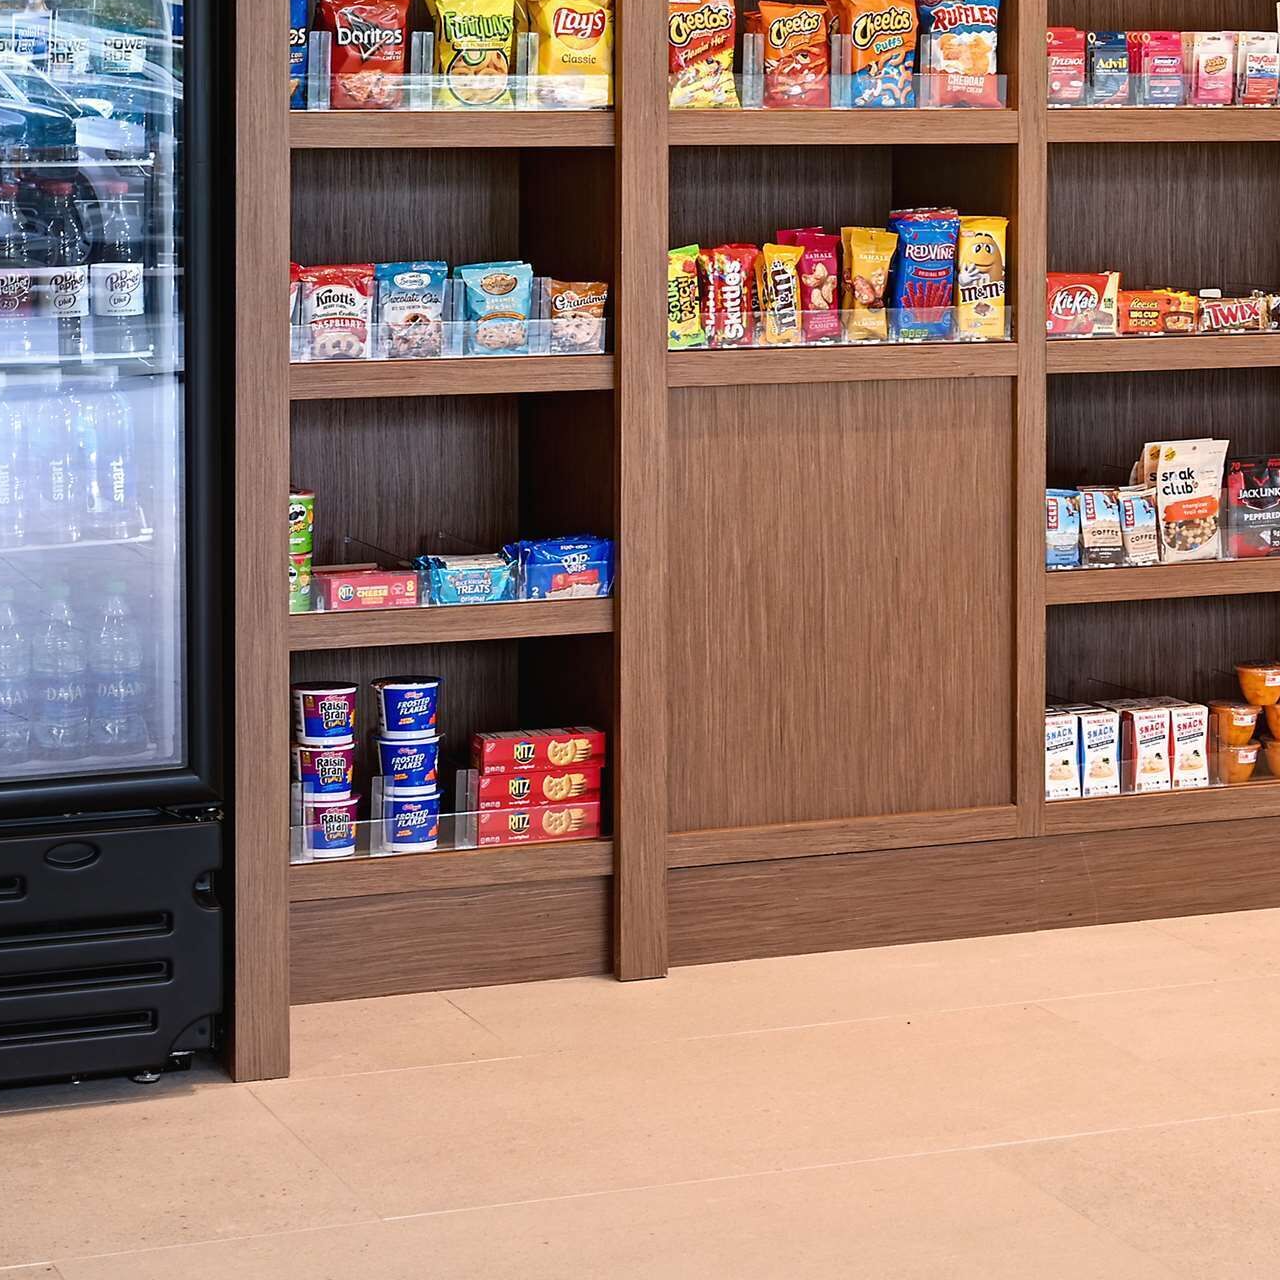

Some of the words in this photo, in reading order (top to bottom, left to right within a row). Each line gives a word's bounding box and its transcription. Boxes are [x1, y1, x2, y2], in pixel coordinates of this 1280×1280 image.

[557, 9, 603, 35] Lay's
[670, 5, 730, 44] Cheetos
[932, 6, 997, 31] RUFFLES
[771, 12, 821, 46] Cheetos
[854, 8, 911, 46] Cheetos
[337, 27, 402, 45] Doritos
[875, 37, 903, 54] Puffs
[562, 53, 597, 64] Classic
[1052, 57, 1083, 66] TYLENOL
[1096, 58, 1127, 69] Advil
[948, 75, 984, 86] CHEDDAR
[51, 275, 84, 293] Pepper
[107, 273, 140, 291] Pepper
[316, 288, 356, 308] Knott's
[668, 280, 680, 321] SOUR
[678, 276, 696, 321] PATCH
[723, 260, 743, 339] Skittles
[1205, 300, 1261, 323] TWIX
[312, 319, 364, 331] RASPBERRY
[50, 460, 64, 501] smart
[110, 456, 125, 502] smart
[1162, 481, 1193, 495] club
[1239, 488, 1259, 500] JACK
[1244, 512, 1280, 521] PEPPERED
[1092, 529, 1119, 537] COFFEE
[1131, 534, 1156, 543] COFFEE
[406, 580, 415, 592] 8
[457, 585, 491, 595] TREATS
[532, 587, 539, 596] 2
[339, 587, 354, 599] RITZ
[320, 703, 348, 712] Raisin
[397, 697, 430, 708] FROSTED
[324, 711, 346, 720] Bran
[400, 705, 428, 716] FLAKES
[1139, 722, 1166, 735] SNACK
[1177, 719, 1204, 732] SNACK
[1046, 727, 1073, 741] SNACK
[1087, 726, 1114, 739] SNACK
[514, 743, 535, 759] RITZ
[316, 758, 345, 767] Raisin
[392, 754, 425, 765] FROSTED
[321, 767, 343, 777] Bran
[394, 761, 421, 771] FLAKES
[509, 779, 530, 794] RITZ
[321, 814, 349, 824] Raisin
[395, 809, 428, 820] FROSTED
[325, 823, 346, 832] Bran
[397, 817, 425, 827] FLAKES
[509, 814, 530, 830] RITZ
